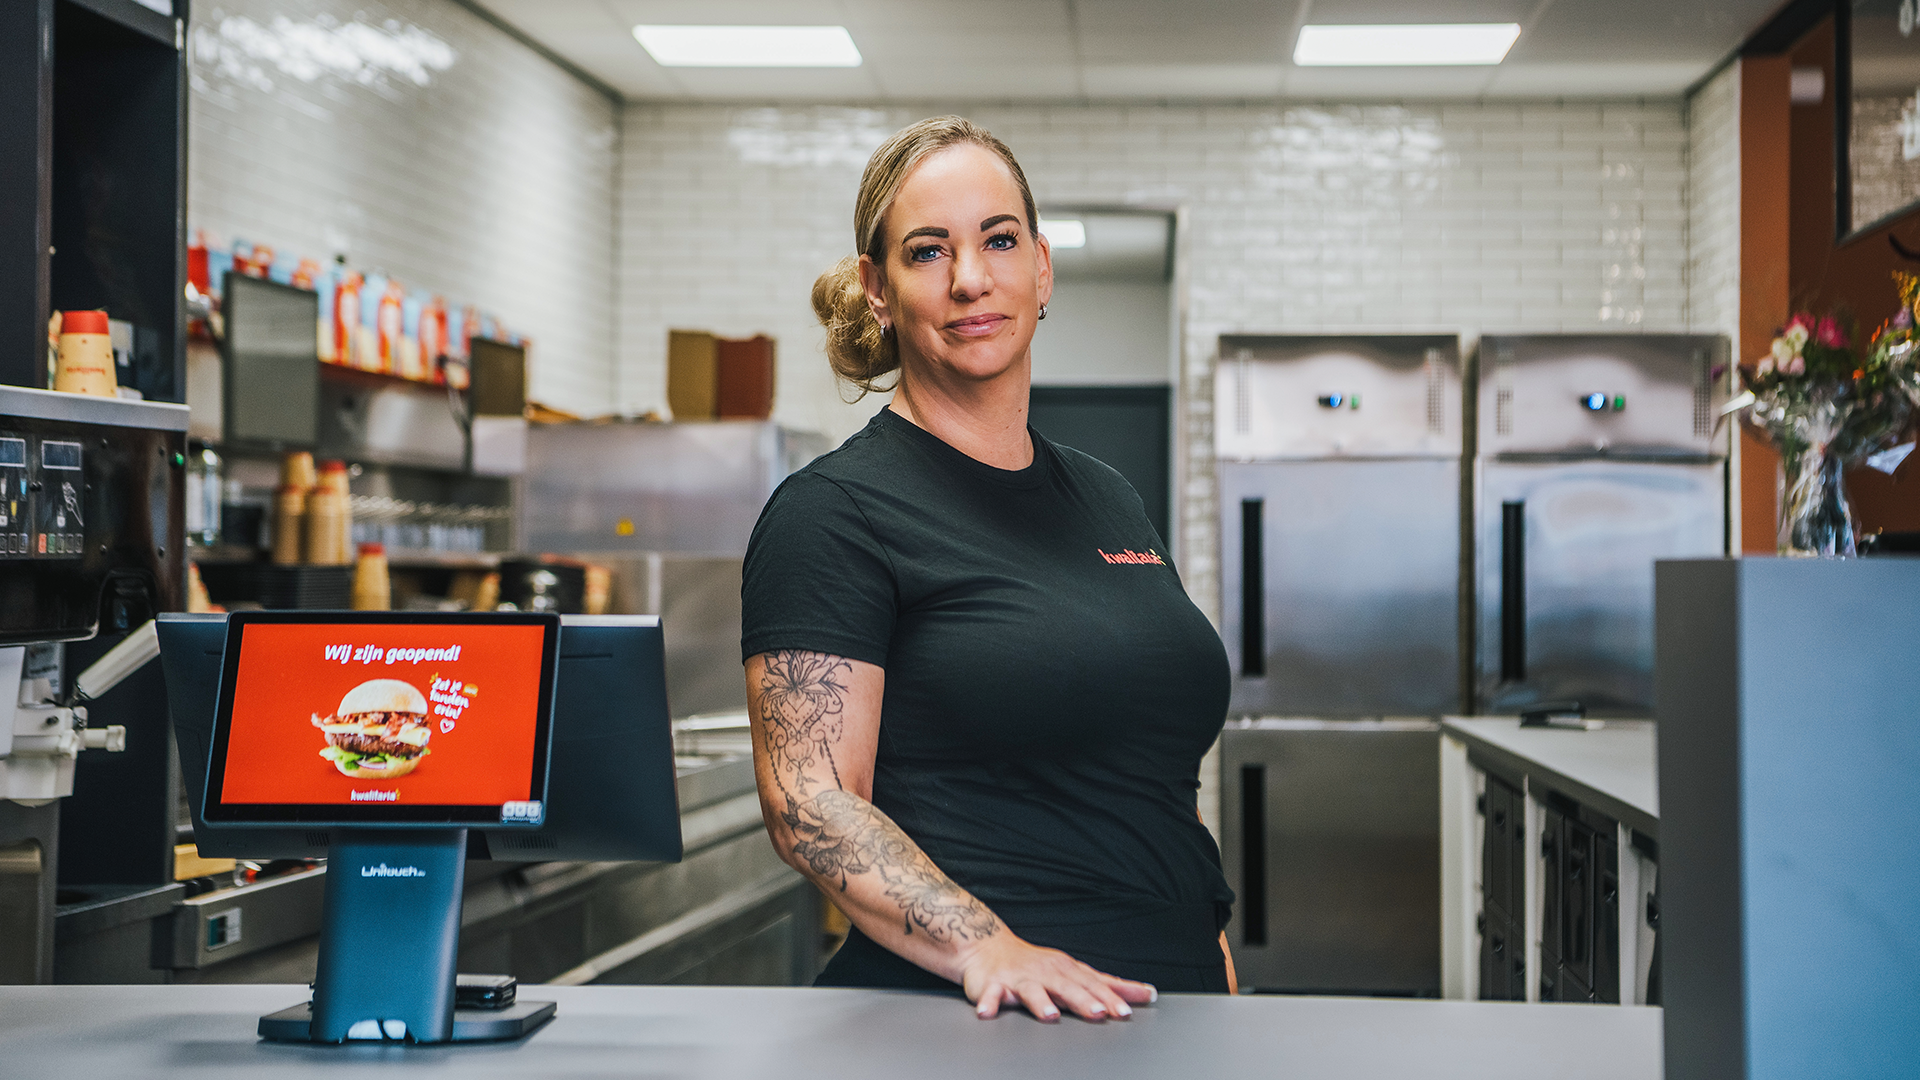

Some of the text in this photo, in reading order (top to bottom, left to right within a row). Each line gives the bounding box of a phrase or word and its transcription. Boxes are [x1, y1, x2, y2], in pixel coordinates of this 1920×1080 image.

[324, 643, 462, 665] Wij zijn geopend!
